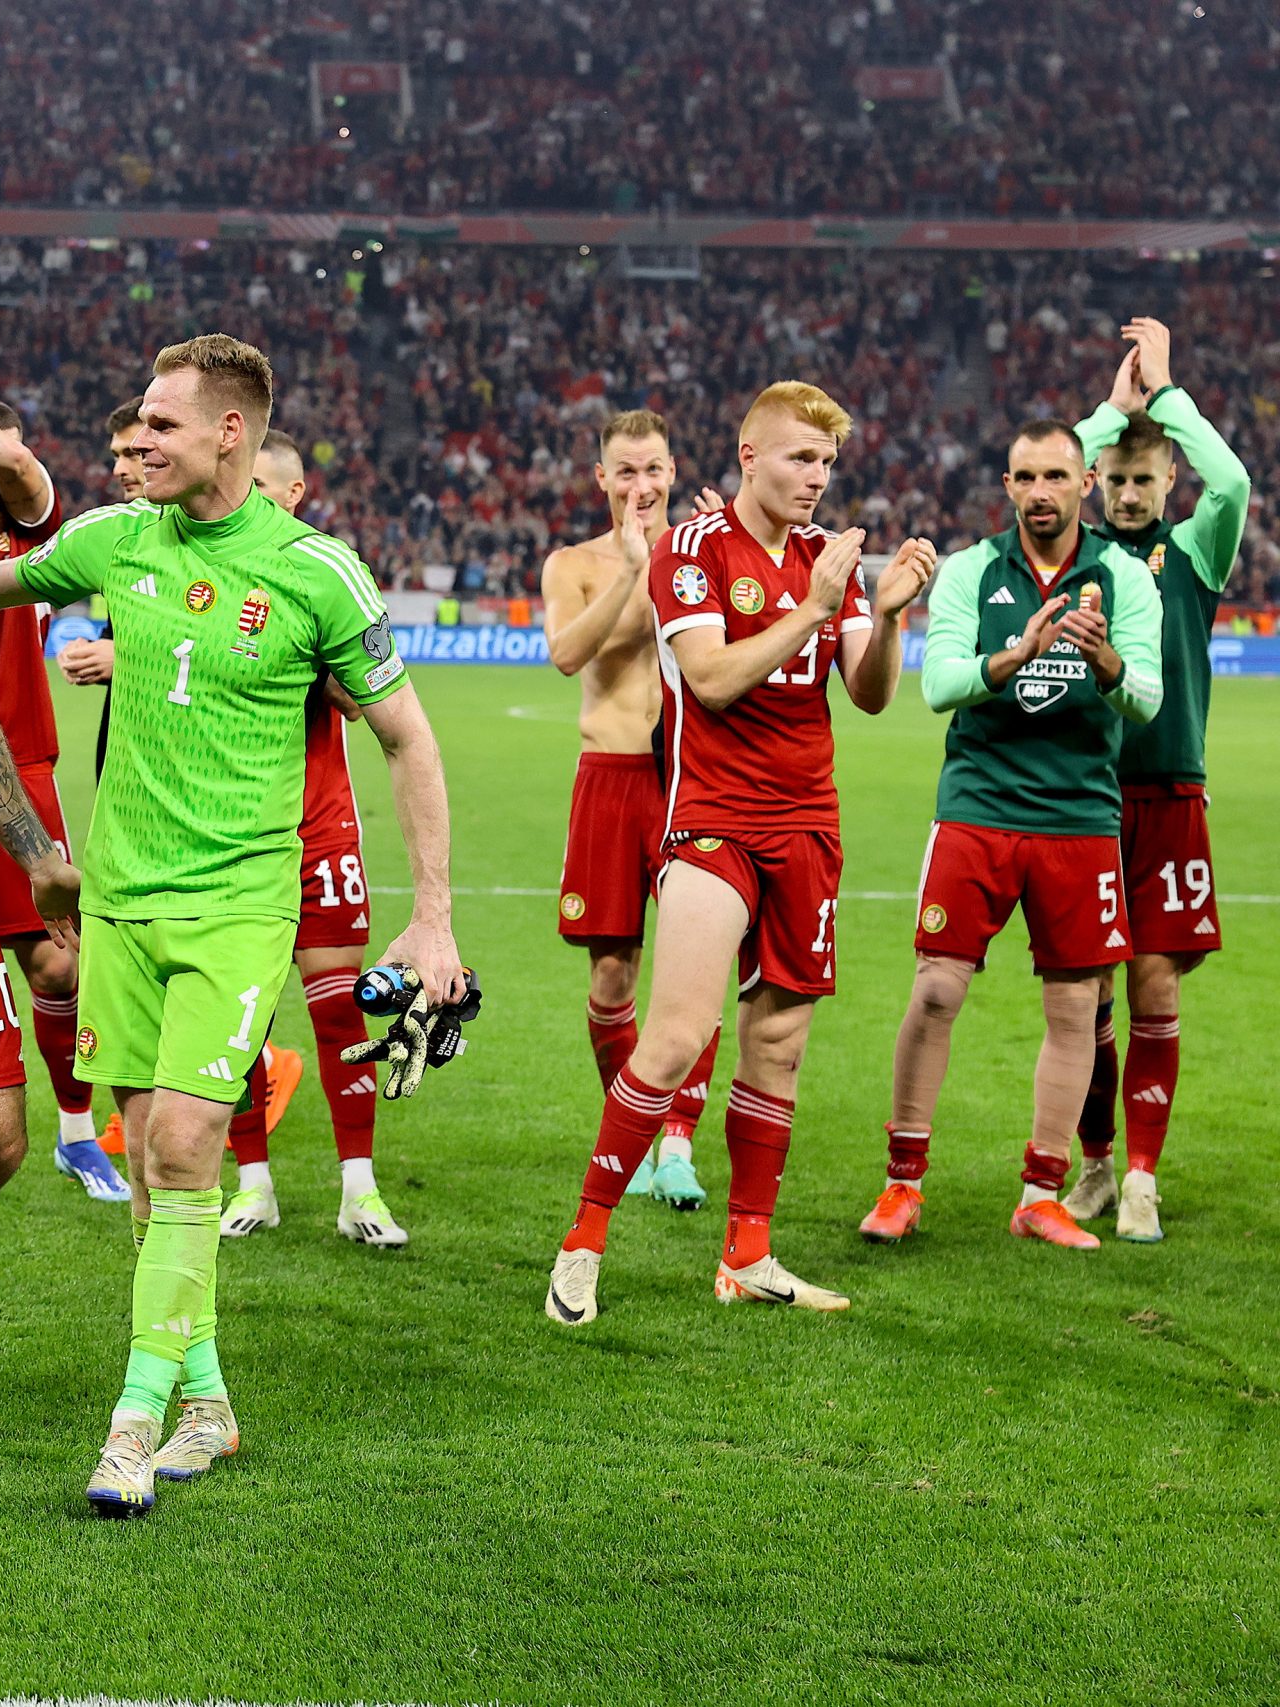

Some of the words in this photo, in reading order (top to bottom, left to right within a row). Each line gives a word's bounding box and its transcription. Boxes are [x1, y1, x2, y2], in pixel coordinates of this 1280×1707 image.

[168, 638, 194, 706] 1
[1022, 684, 1049, 698] MOL
[314, 854, 366, 907] 18
[1098, 871, 1117, 924] 5
[1159, 859, 1211, 912] 19
[227, 984, 261, 1052] 1
